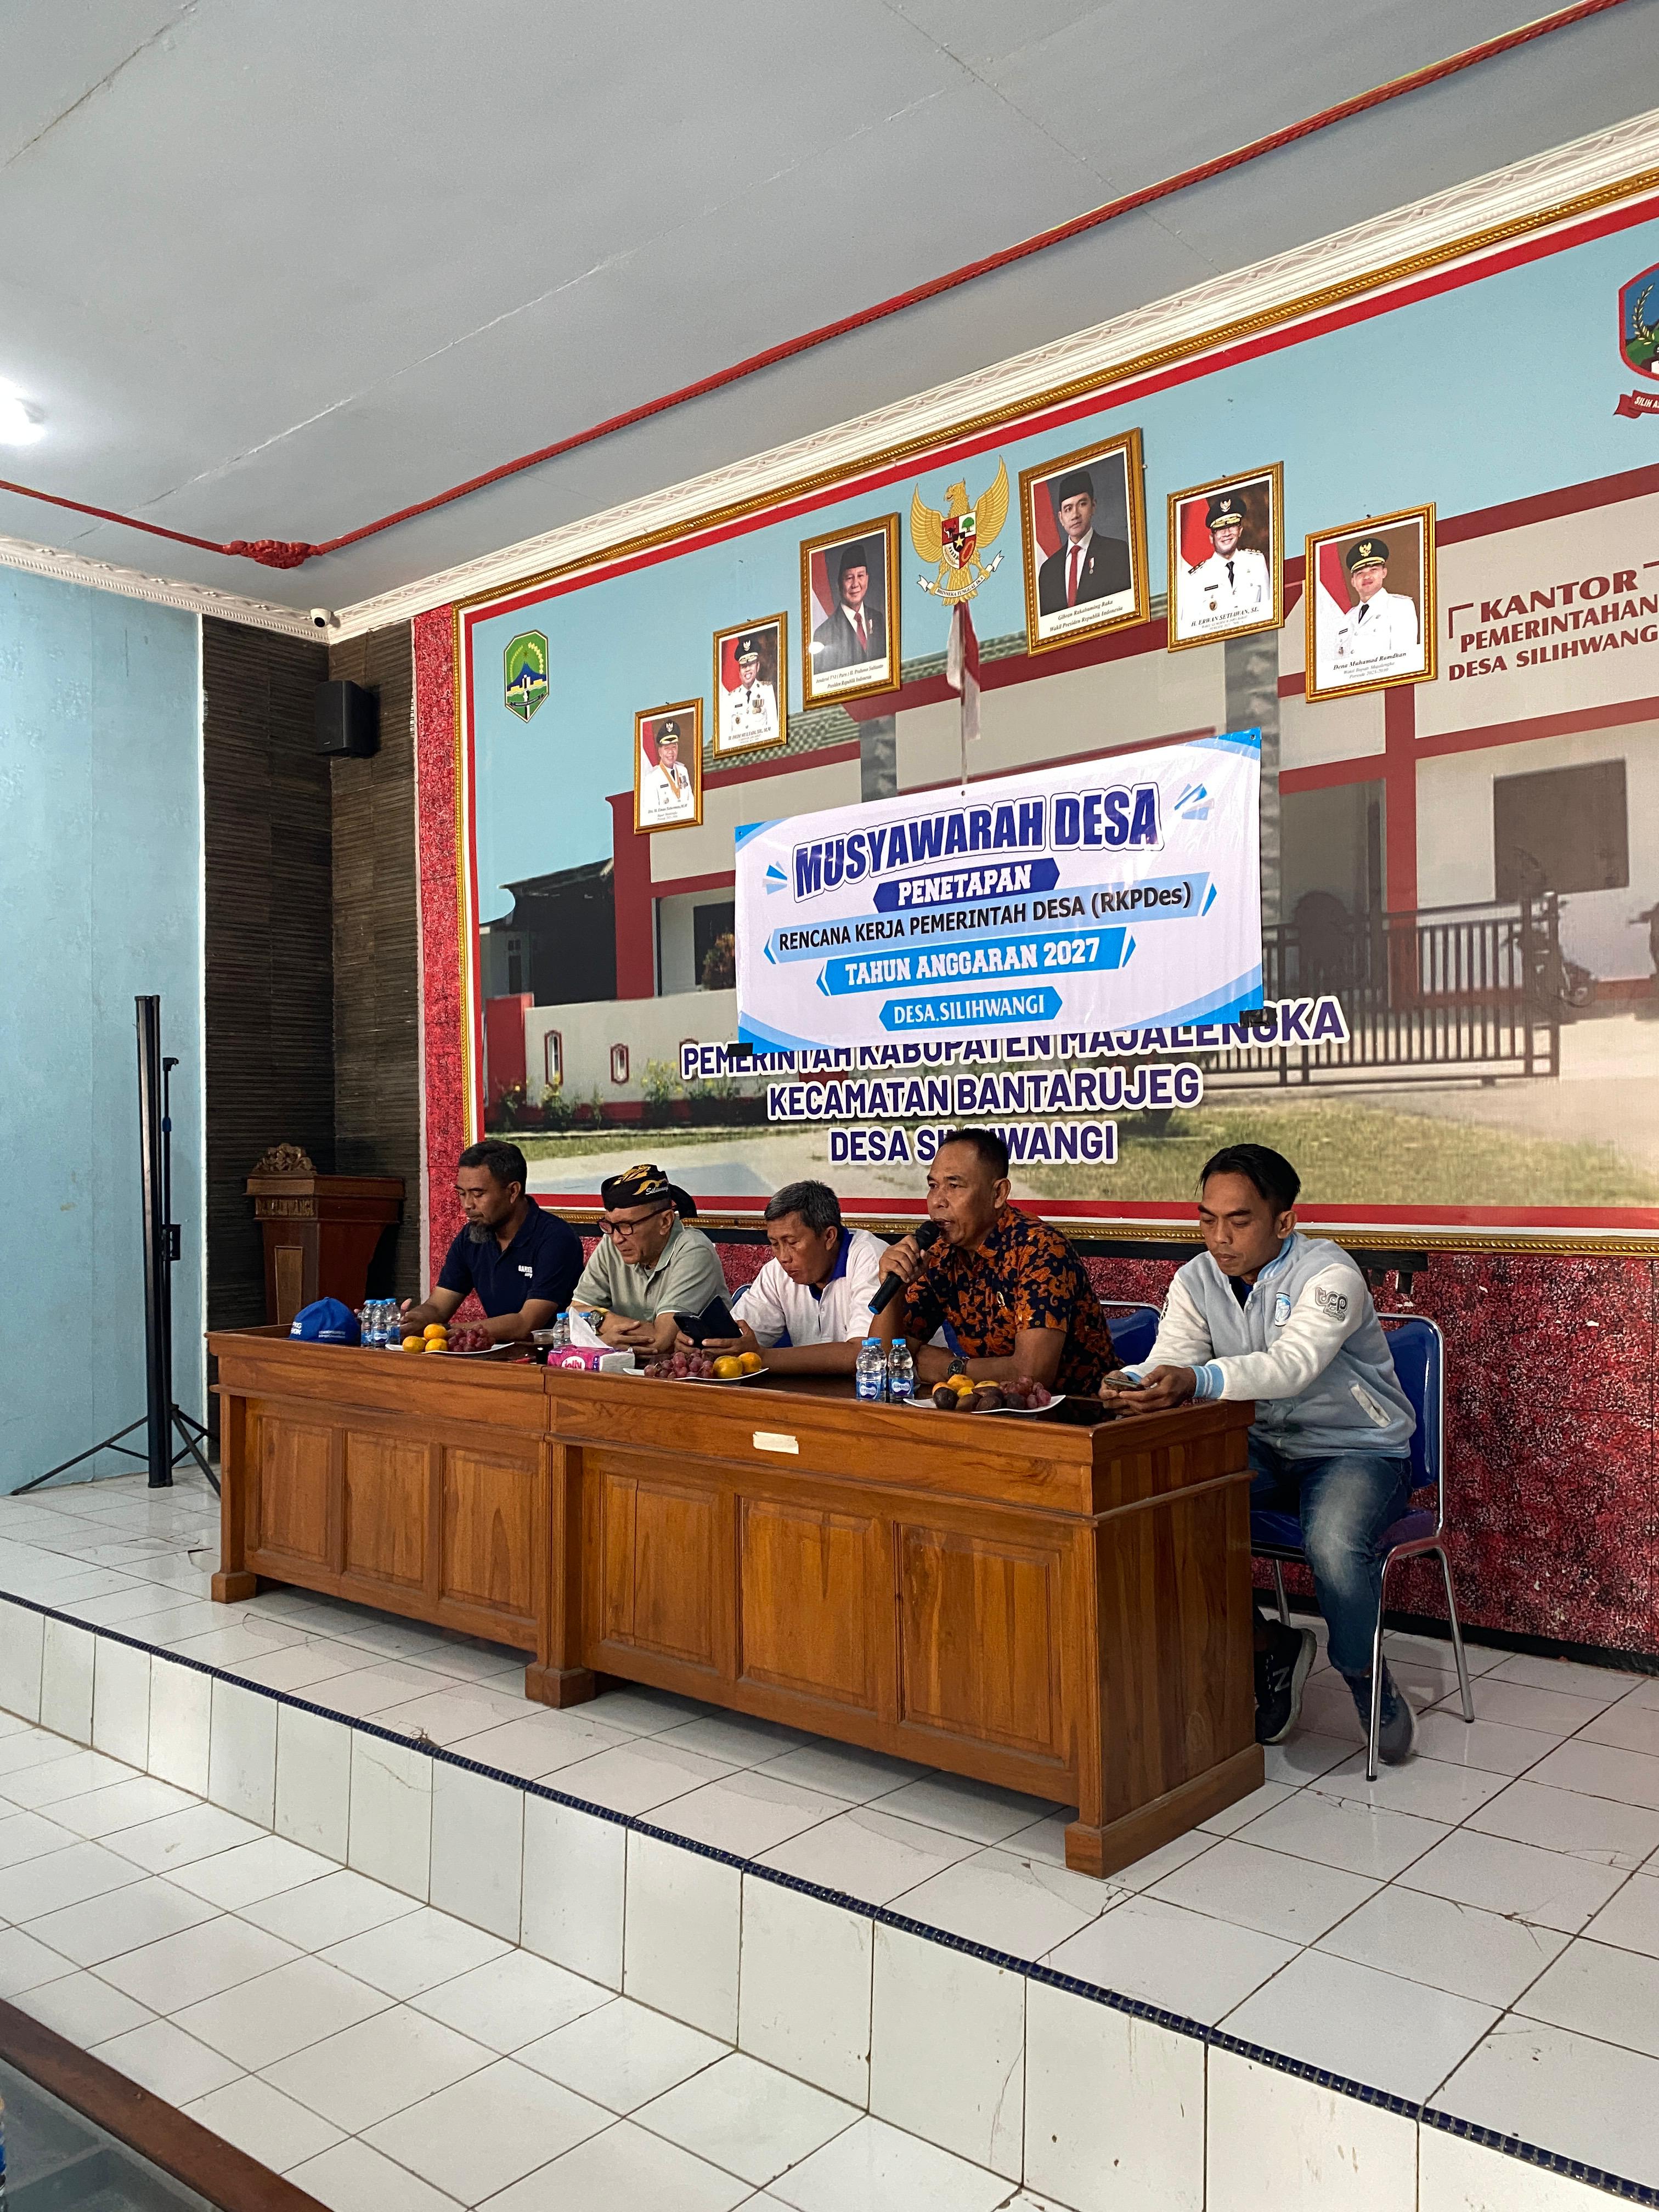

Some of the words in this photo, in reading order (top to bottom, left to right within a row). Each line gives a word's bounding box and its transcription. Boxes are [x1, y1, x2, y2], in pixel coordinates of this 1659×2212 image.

[1634, 396, 1653, 408] SILIH
[1481, 569, 1638, 623] KANTOR
[1199, 616, 1218, 625] ERWAN
[1461, 594, 1658, 653] PEMERINTAHAN
[1449, 656, 1508, 681] DESA
[796, 800, 1042, 898] MUSYAWARAH
[1055, 788, 1159, 845] DESA
[898, 865, 1031, 906] PENETAPAN
[780, 926, 851, 951] RENCANA
[855, 919, 905, 942] KERJA
[910, 904, 1025, 935] PEMERINTAH
[1034, 896, 1085, 921] DESA
[1092, 882, 1192, 918] (RKPDes)
[845, 958, 911, 985] TAHUN
[916, 944, 1038, 979] ANGGARAN
[1043, 937, 1099, 966] 2027
[770, 1080, 947, 1116] KECAMATAN
[958, 1069, 1199, 1110] BANTARUJEG
[831, 1131, 909, 1161] DESA
